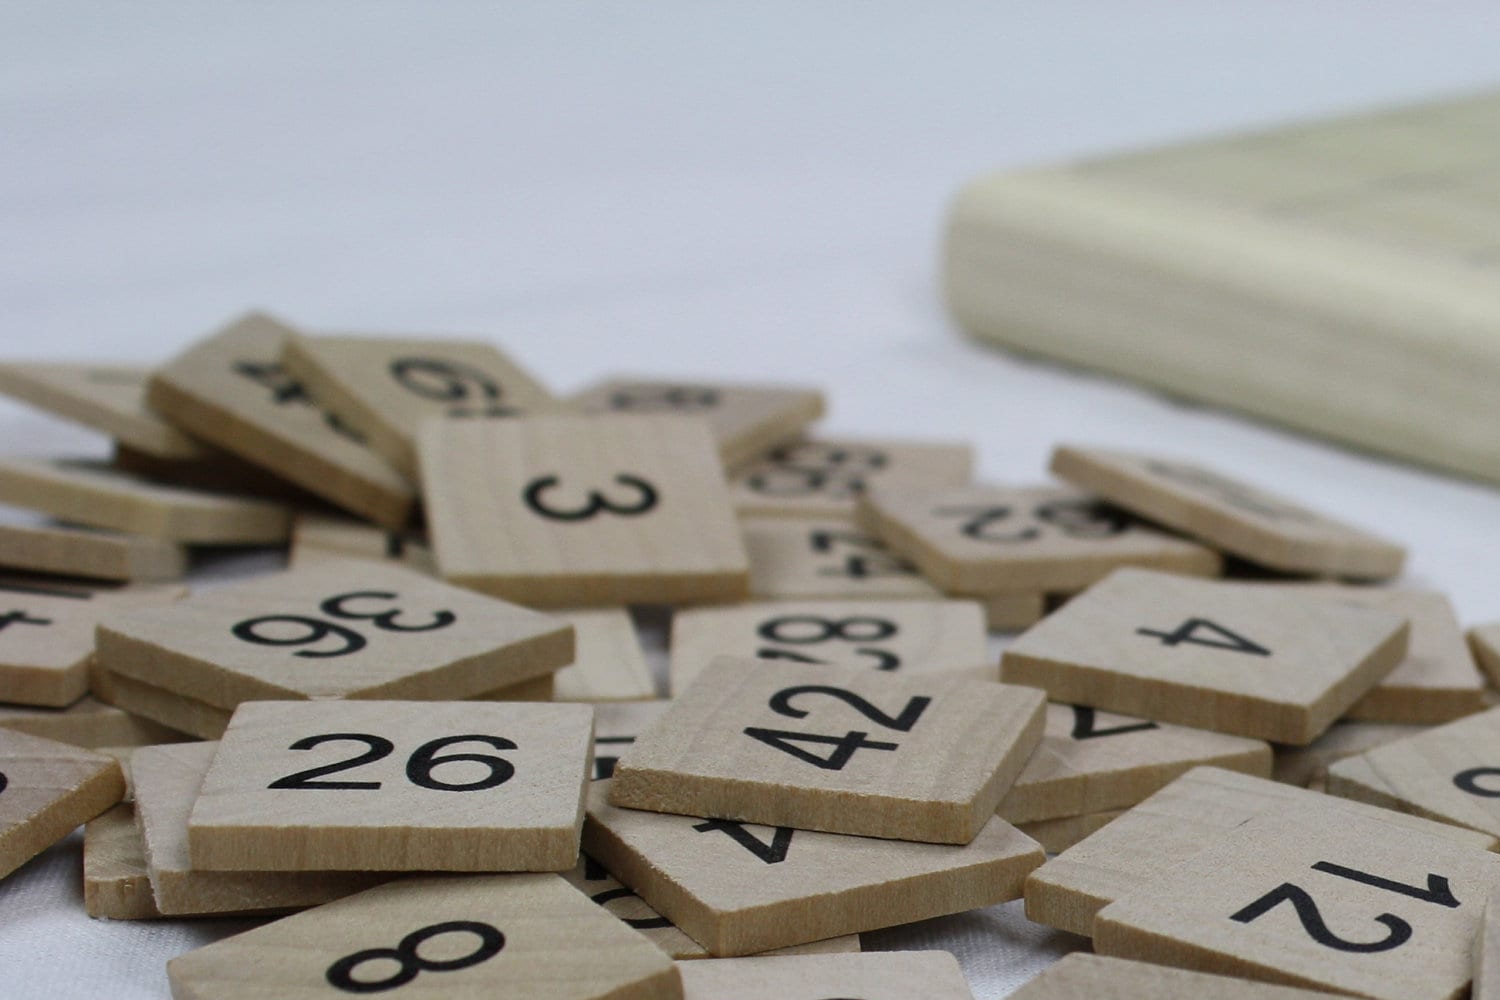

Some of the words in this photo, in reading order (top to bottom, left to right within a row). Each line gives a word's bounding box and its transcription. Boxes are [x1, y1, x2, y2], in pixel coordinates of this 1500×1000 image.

[523, 475, 659, 522] 3
[231, 591, 456, 659] 36
[1137, 617, 1271, 656] 4
[744, 685, 932, 770] 42
[266, 733, 518, 792] 26
[1230, 861, 1462, 953] 12
[326, 920, 506, 993] 8
